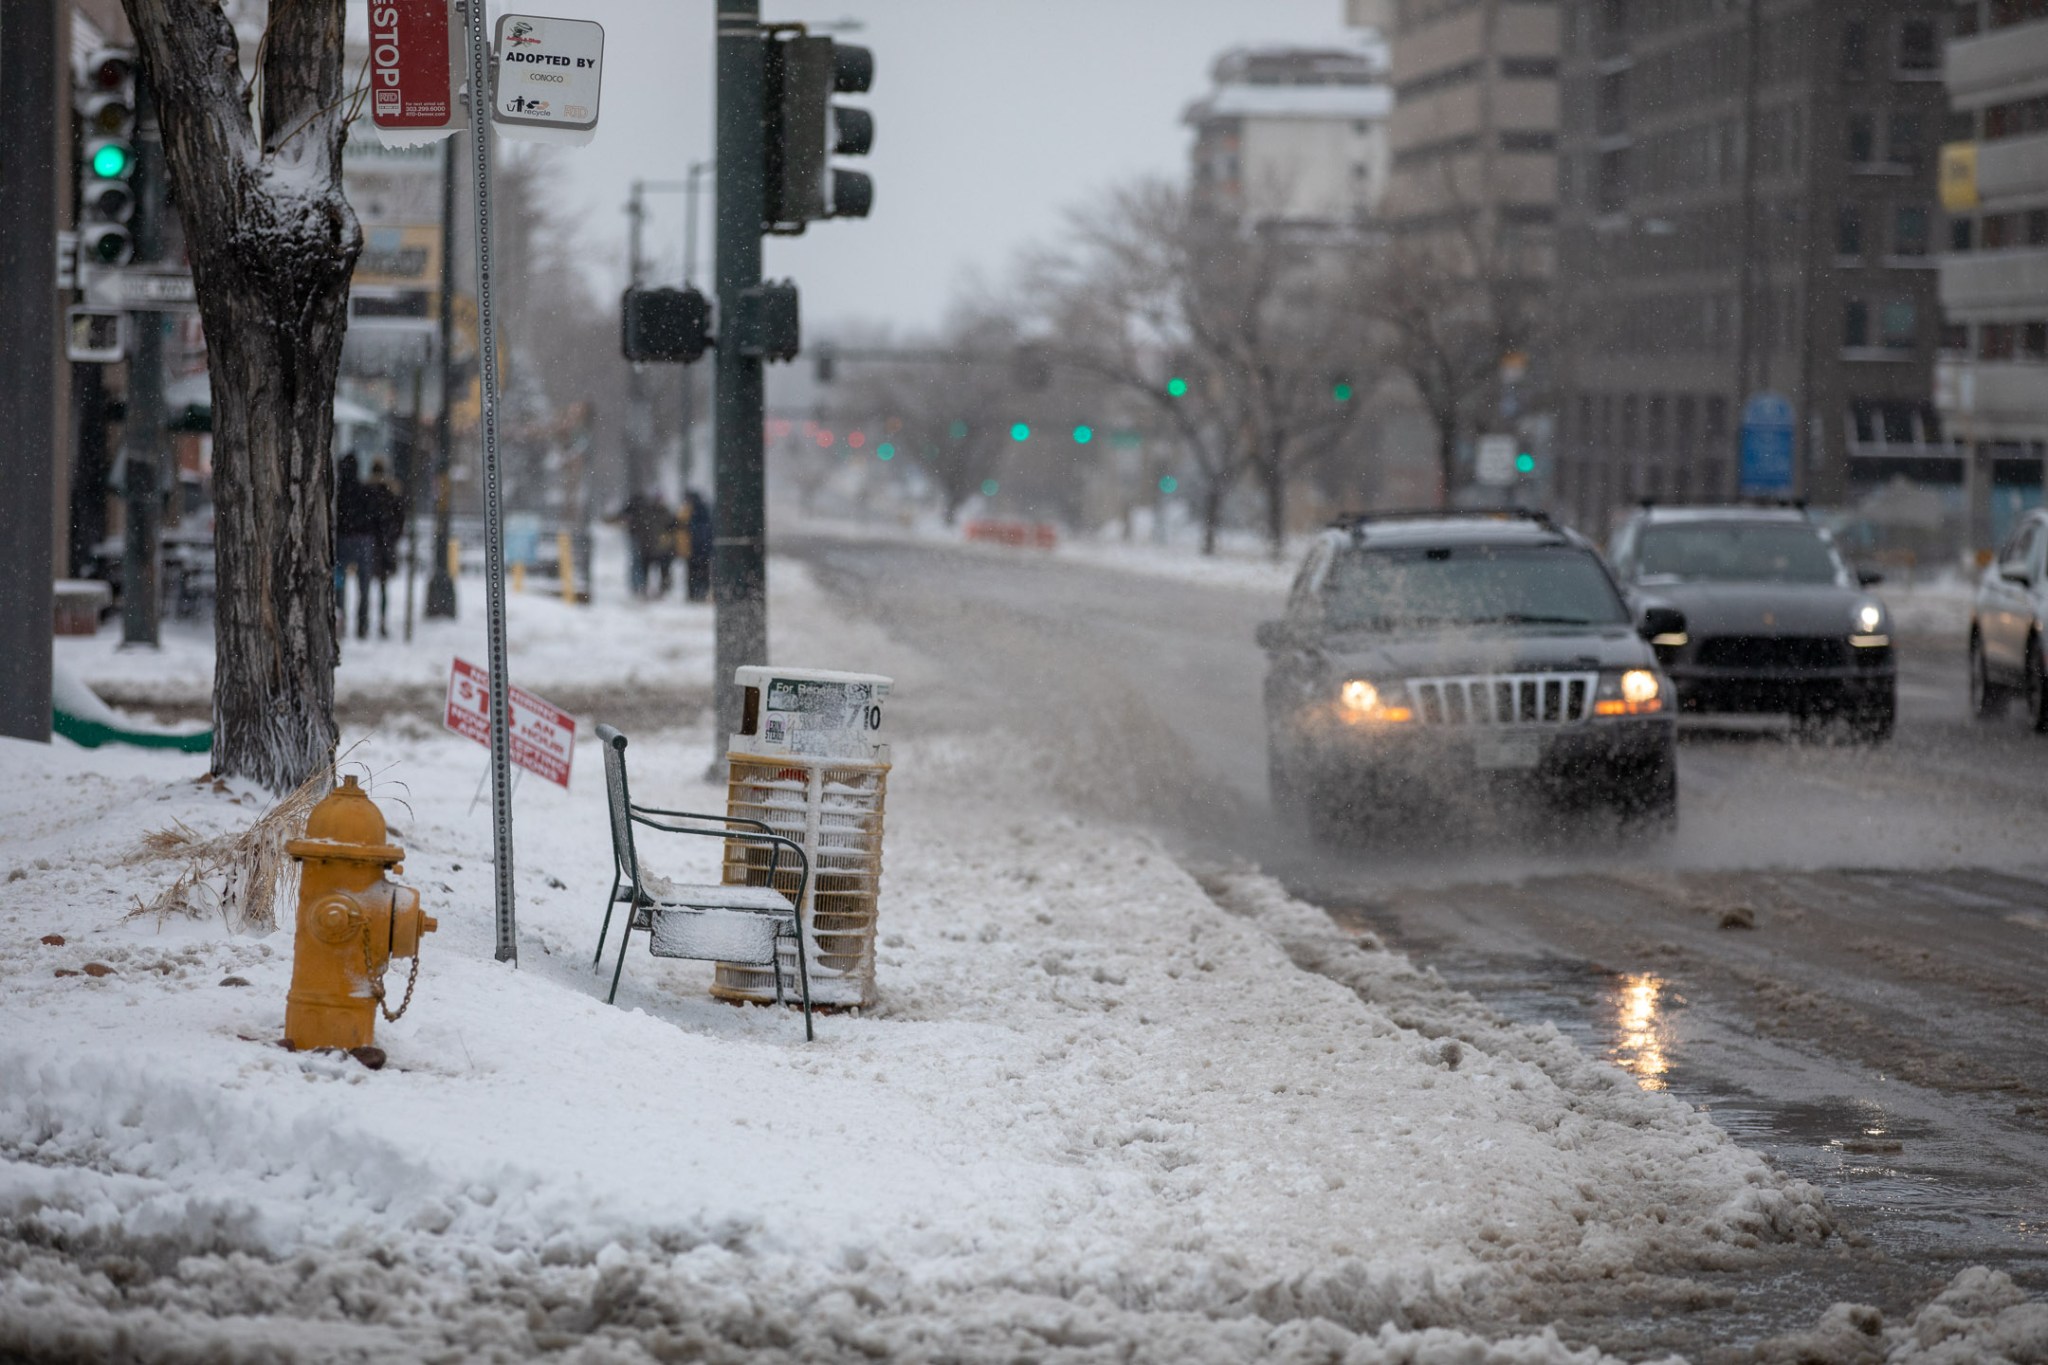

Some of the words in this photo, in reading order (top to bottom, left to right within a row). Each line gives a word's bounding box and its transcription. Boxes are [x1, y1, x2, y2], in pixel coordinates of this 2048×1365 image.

[506, 51, 571, 66] ADOPTED
[576, 58, 597, 69] BY
[529, 73, 564, 83] CONOCO
[378, 91, 398, 103] RTD
[524, 108, 552, 117] recycle
[563, 104, 589, 119] RTD
[776, 682, 794, 693] For
[533, 720, 556, 737] AN
[520, 724, 565, 755] HOUR
